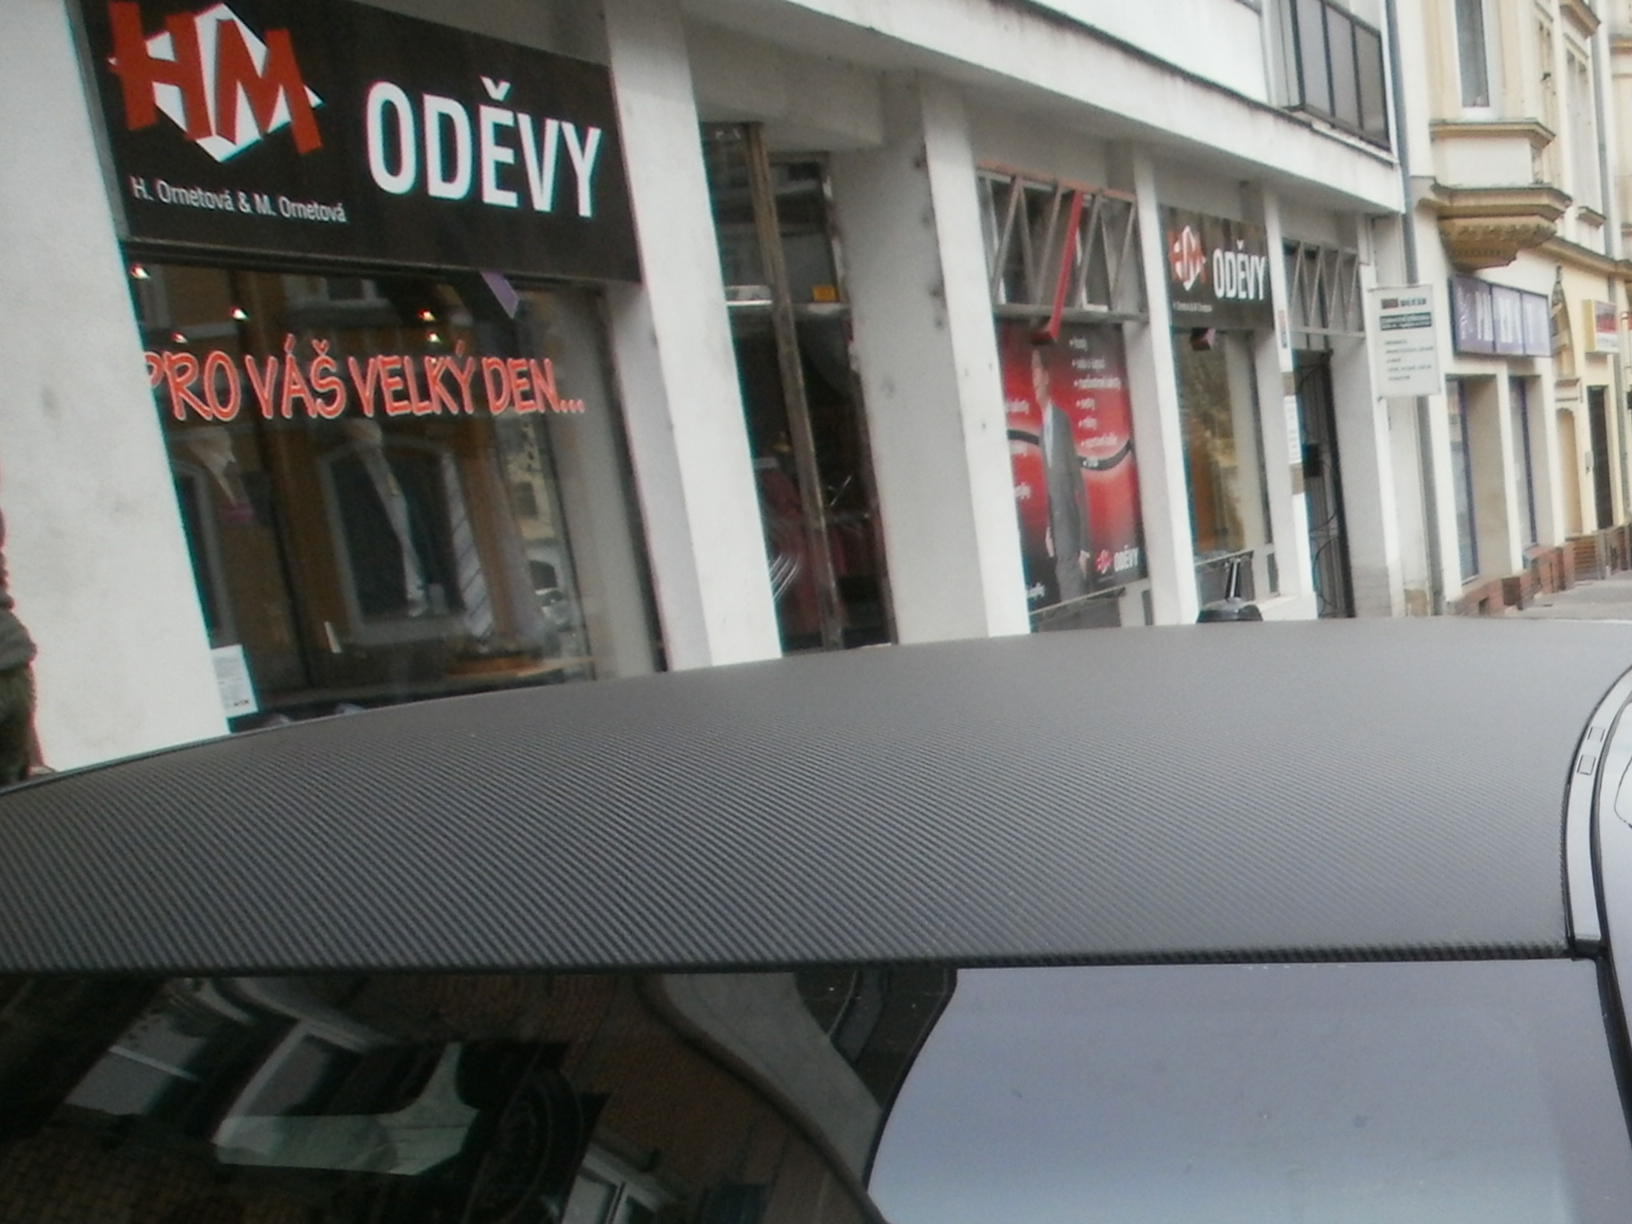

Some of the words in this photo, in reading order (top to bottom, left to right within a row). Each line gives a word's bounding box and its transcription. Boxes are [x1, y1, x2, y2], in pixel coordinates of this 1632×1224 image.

[107, 0, 322, 154] HM
[367, 75, 602, 218] ODĚVY
[130, 176, 154, 200] H.
[239, 191, 252, 213] &
[253, 192, 277, 215] M.
[1213, 239, 1267, 301] ODĚVY
[244, 333, 346, 419] VÁŠ
[348, 340, 476, 418] VELKÝ
[482, 357, 586, 415] DEN...
